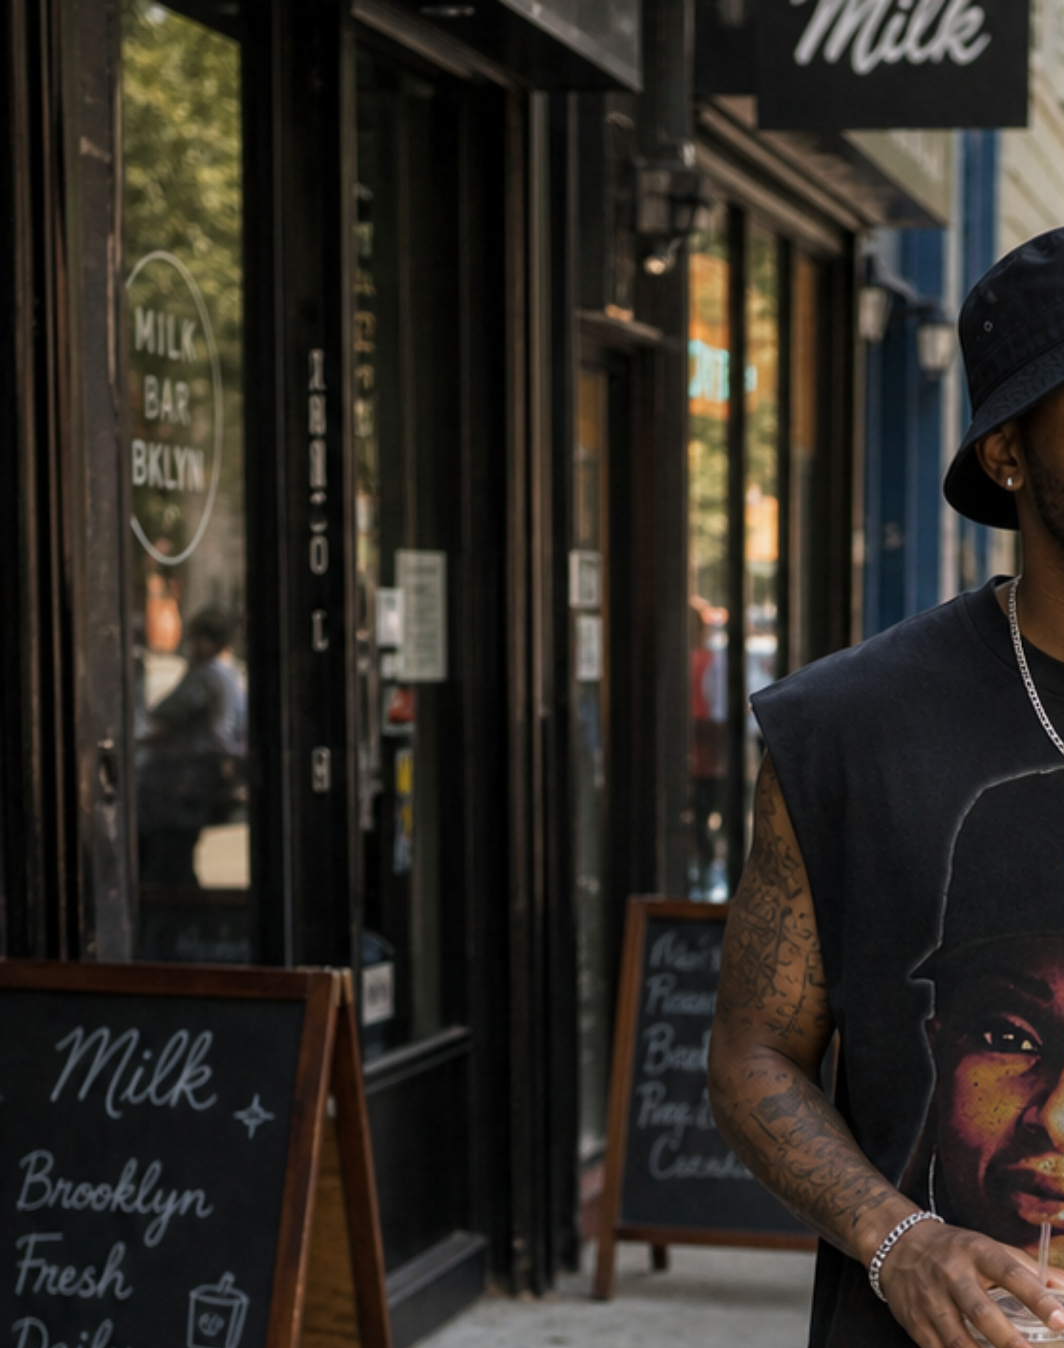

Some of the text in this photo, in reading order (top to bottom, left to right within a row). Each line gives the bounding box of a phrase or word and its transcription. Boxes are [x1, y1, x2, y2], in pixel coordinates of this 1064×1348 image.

[791, 0, 992, 75] Milk
[134, 306, 197, 362] MILK
[144, 375, 190, 426] BAR
[131, 439, 206, 493] BKLYN
[51, 1026, 217, 1118] Milk
[16, 1150, 213, 1247] Brooklyn
[16, 1232, 132, 1298] Fresh
